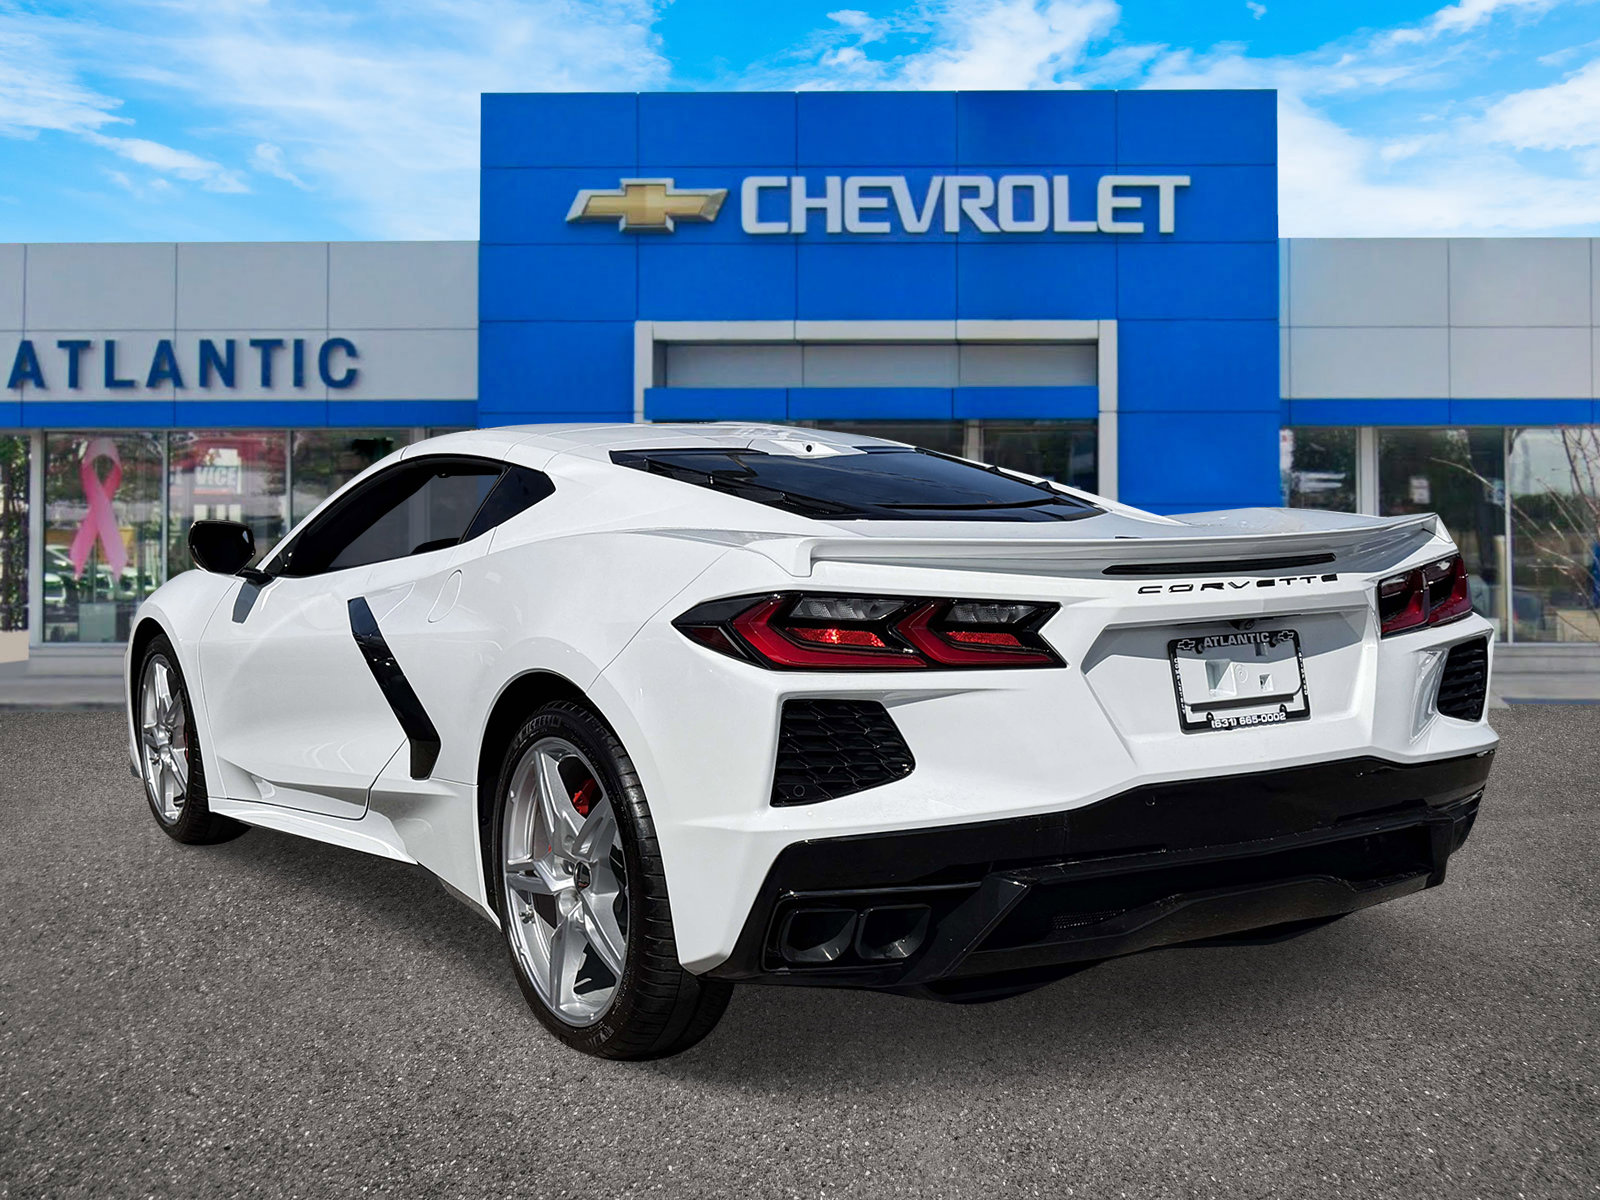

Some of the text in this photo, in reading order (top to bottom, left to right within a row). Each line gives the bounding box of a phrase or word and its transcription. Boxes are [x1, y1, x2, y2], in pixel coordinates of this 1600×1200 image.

[741, 175, 1191, 234] CHEVROLET
[7, 337, 360, 389] ATLANTIC
[1138, 574, 1338, 595] CORVETTE
[1204, 632, 1270, 648] ATLANTIC
[1211, 712, 1287, 728] (631) 665-0002
